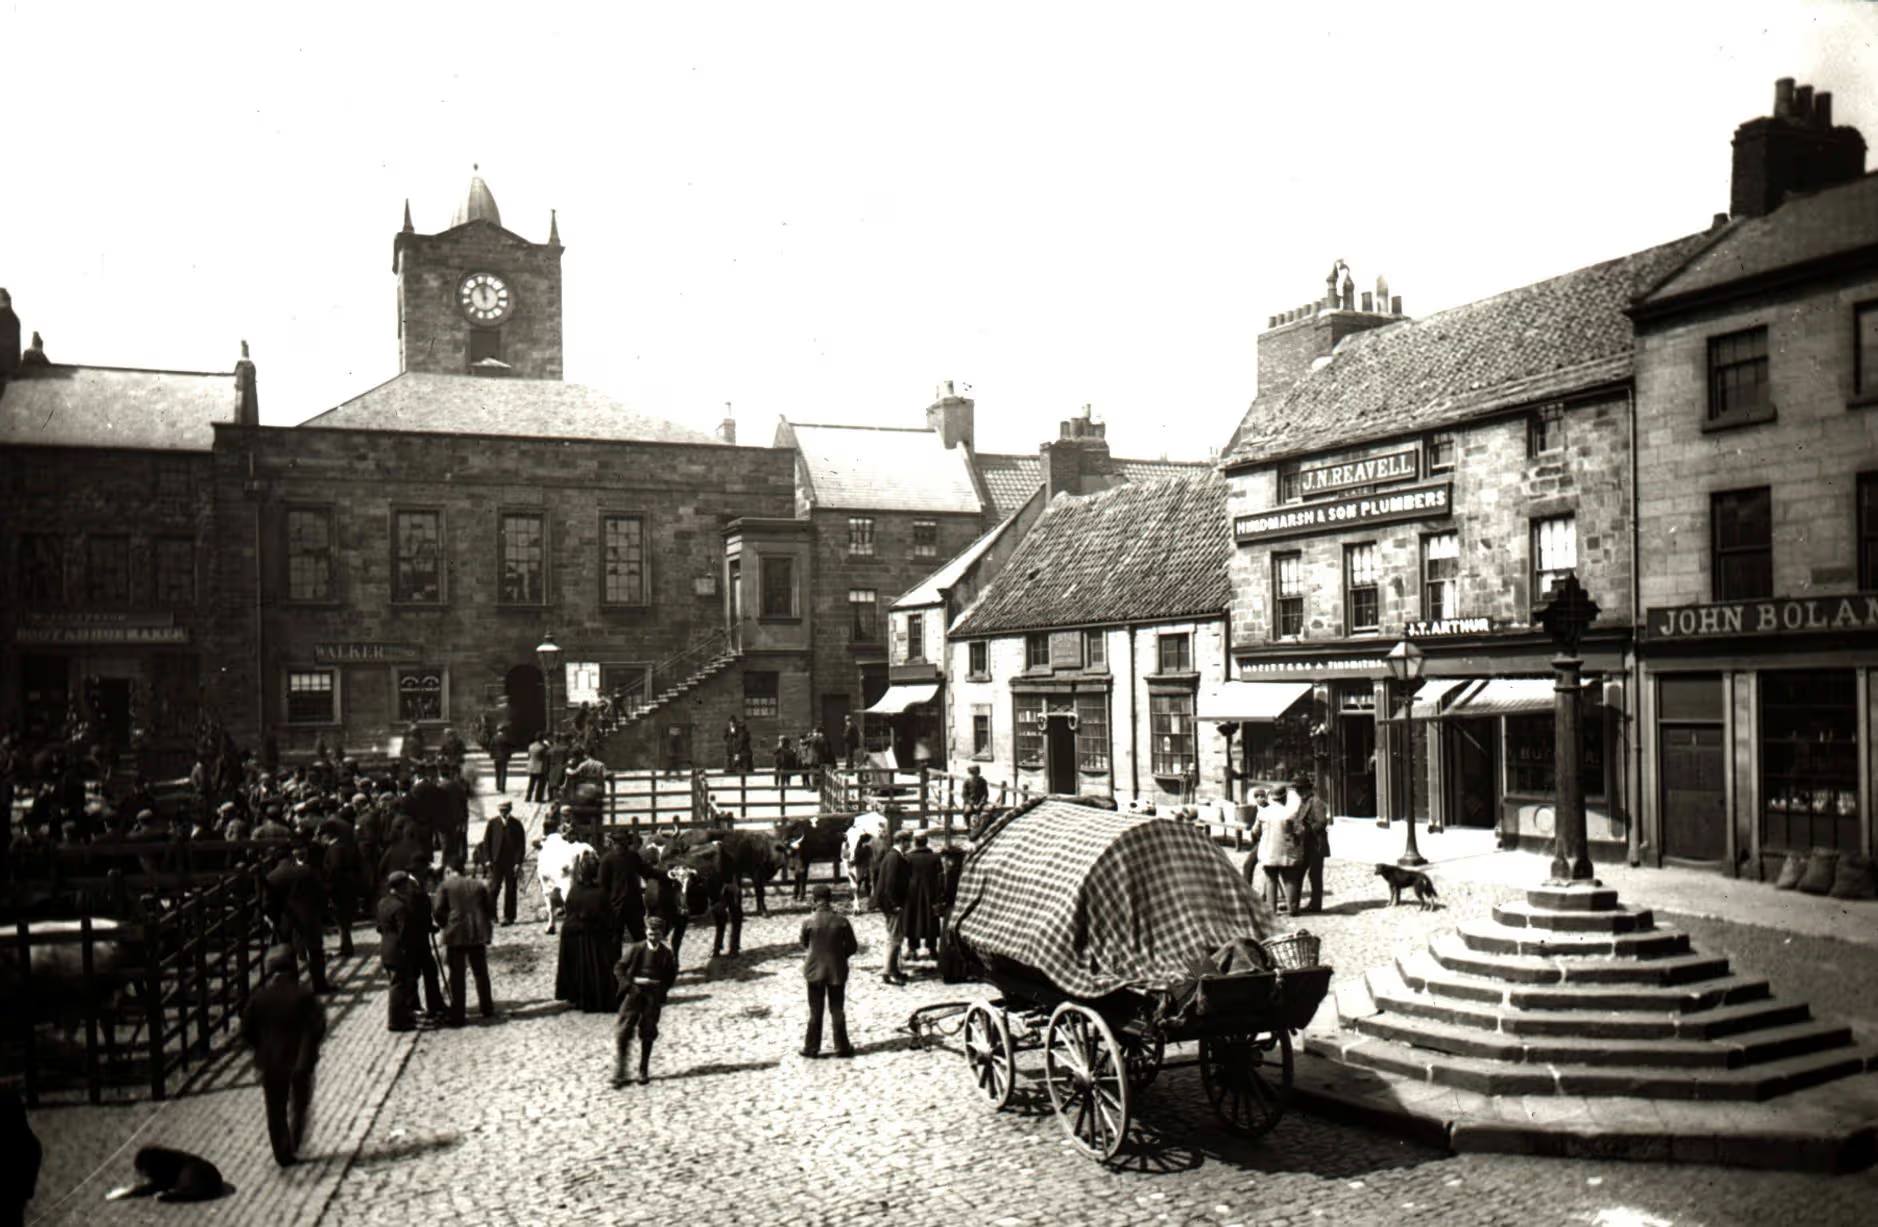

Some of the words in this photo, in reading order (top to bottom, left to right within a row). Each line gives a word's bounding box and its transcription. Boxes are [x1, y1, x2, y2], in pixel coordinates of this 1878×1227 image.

[1236, 510, 1315, 535] HINDMARSH
[1316, 509, 1327, 523] &
[1328, 504, 1357, 521] SON
[1360, 490, 1447, 517] PLUMBERS
[1659, 605, 1744, 636] JOHN
